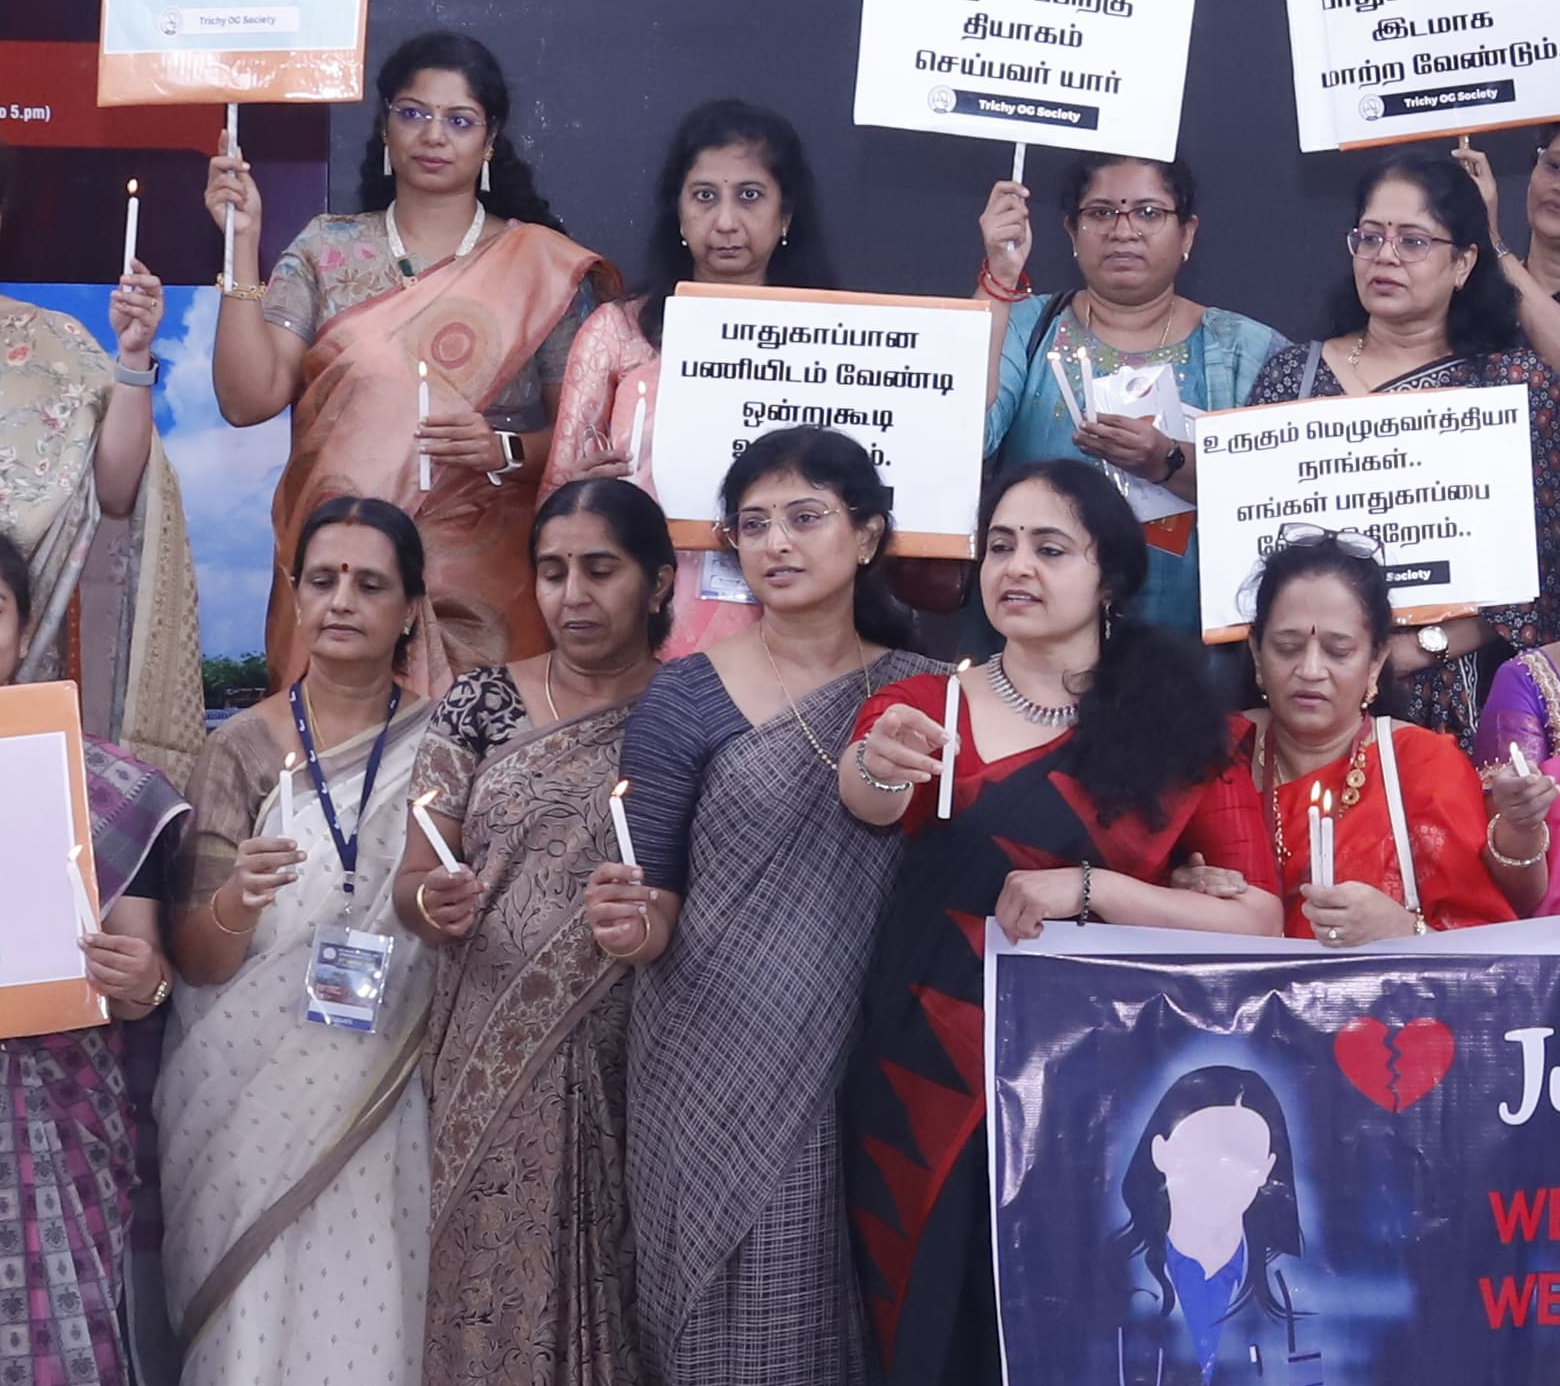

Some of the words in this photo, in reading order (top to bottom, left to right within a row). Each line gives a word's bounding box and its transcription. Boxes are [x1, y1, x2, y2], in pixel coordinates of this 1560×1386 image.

[961, 12, 1083, 47] தியாகம்
[1372, 11, 1493, 41] இடமாக
[915, 49, 1051, 85] செய்பவர்
[1060, 70, 1121, 94] யார்
[1321, 59, 1404, 90] மாற்ற
[722, 323, 919, 349] பாதுகாப்பான
[681, 359, 827, 384] பணியிடம்
[836, 364, 954, 396] வேண்டி
